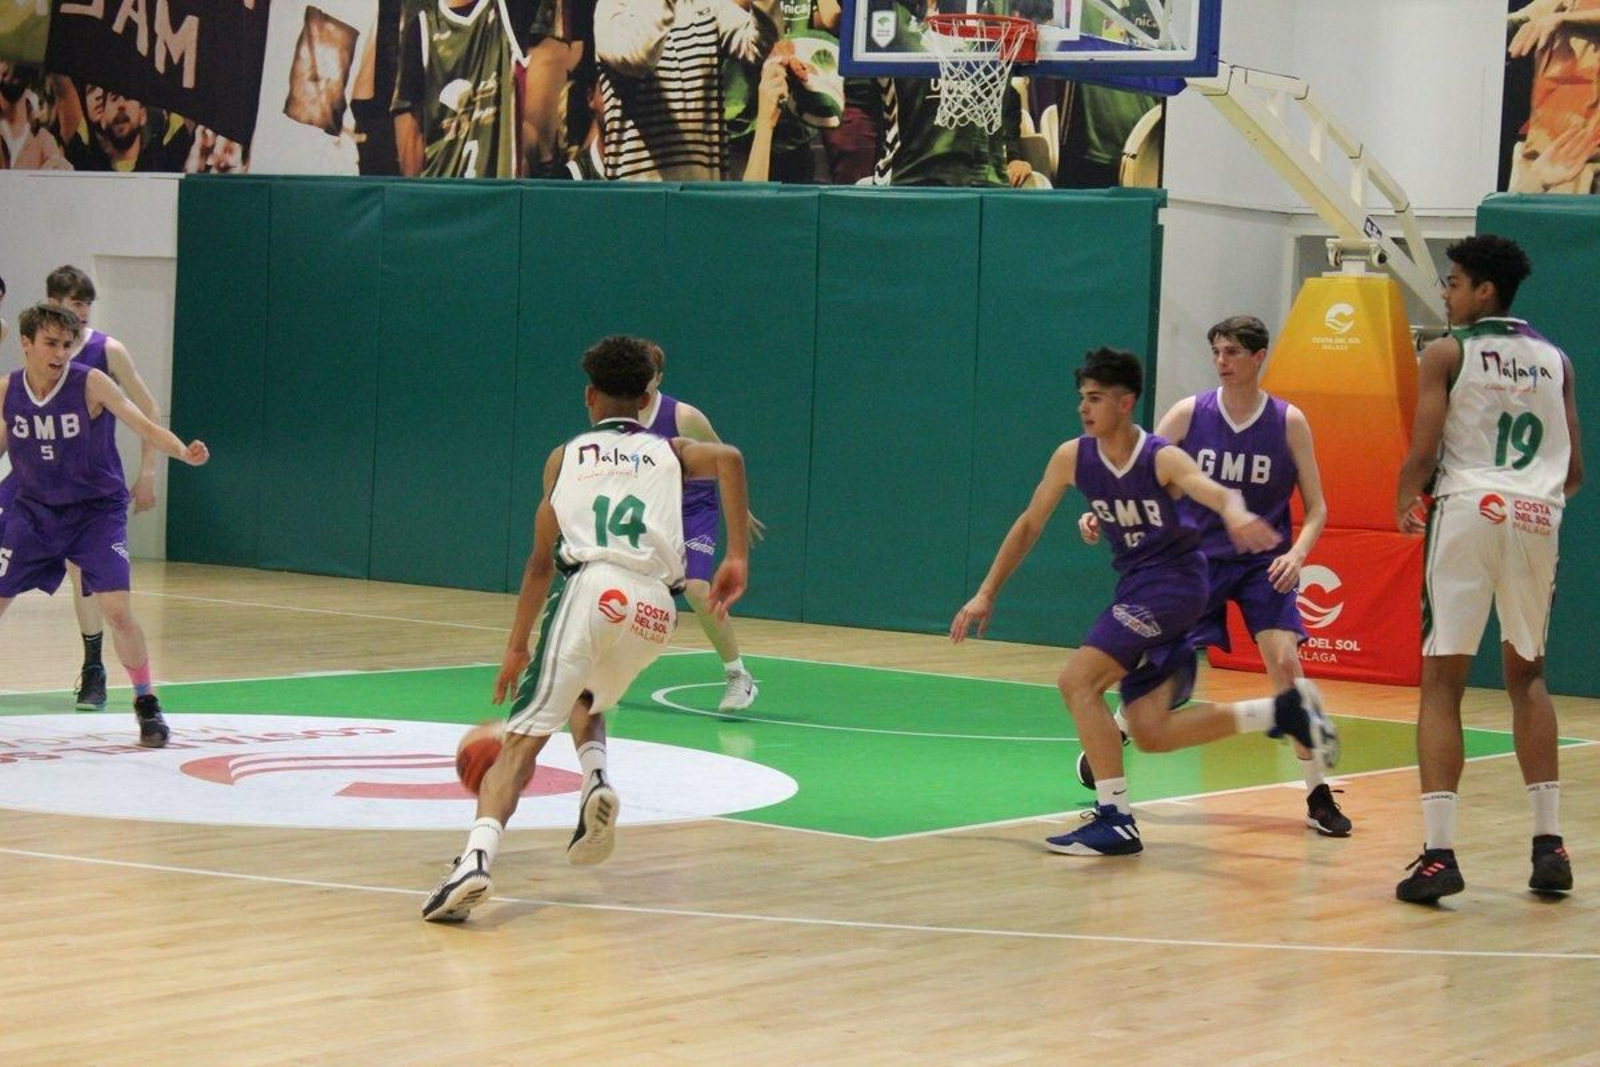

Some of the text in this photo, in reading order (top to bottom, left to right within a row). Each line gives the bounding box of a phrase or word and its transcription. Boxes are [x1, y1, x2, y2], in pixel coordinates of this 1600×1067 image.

[1481, 351, 1552, 386] Málaga
[12, 413, 81, 441] GMB
[1494, 411, 1544, 471] 19
[40, 445, 54, 461] 5
[578, 443, 657, 472] Málaga
[1197, 448, 1272, 485] GMB
[591, 494, 647, 549] 14
[1091, 499, 1164, 528] GMB
[1514, 500, 1552, 516] COSTA
[1515, 511, 1552, 527] DEL SOL
[634, 613, 668, 635] DEL SOL
[636, 601, 671, 623] COSTA
[1308, 637, 1361, 652] DEL SOL
